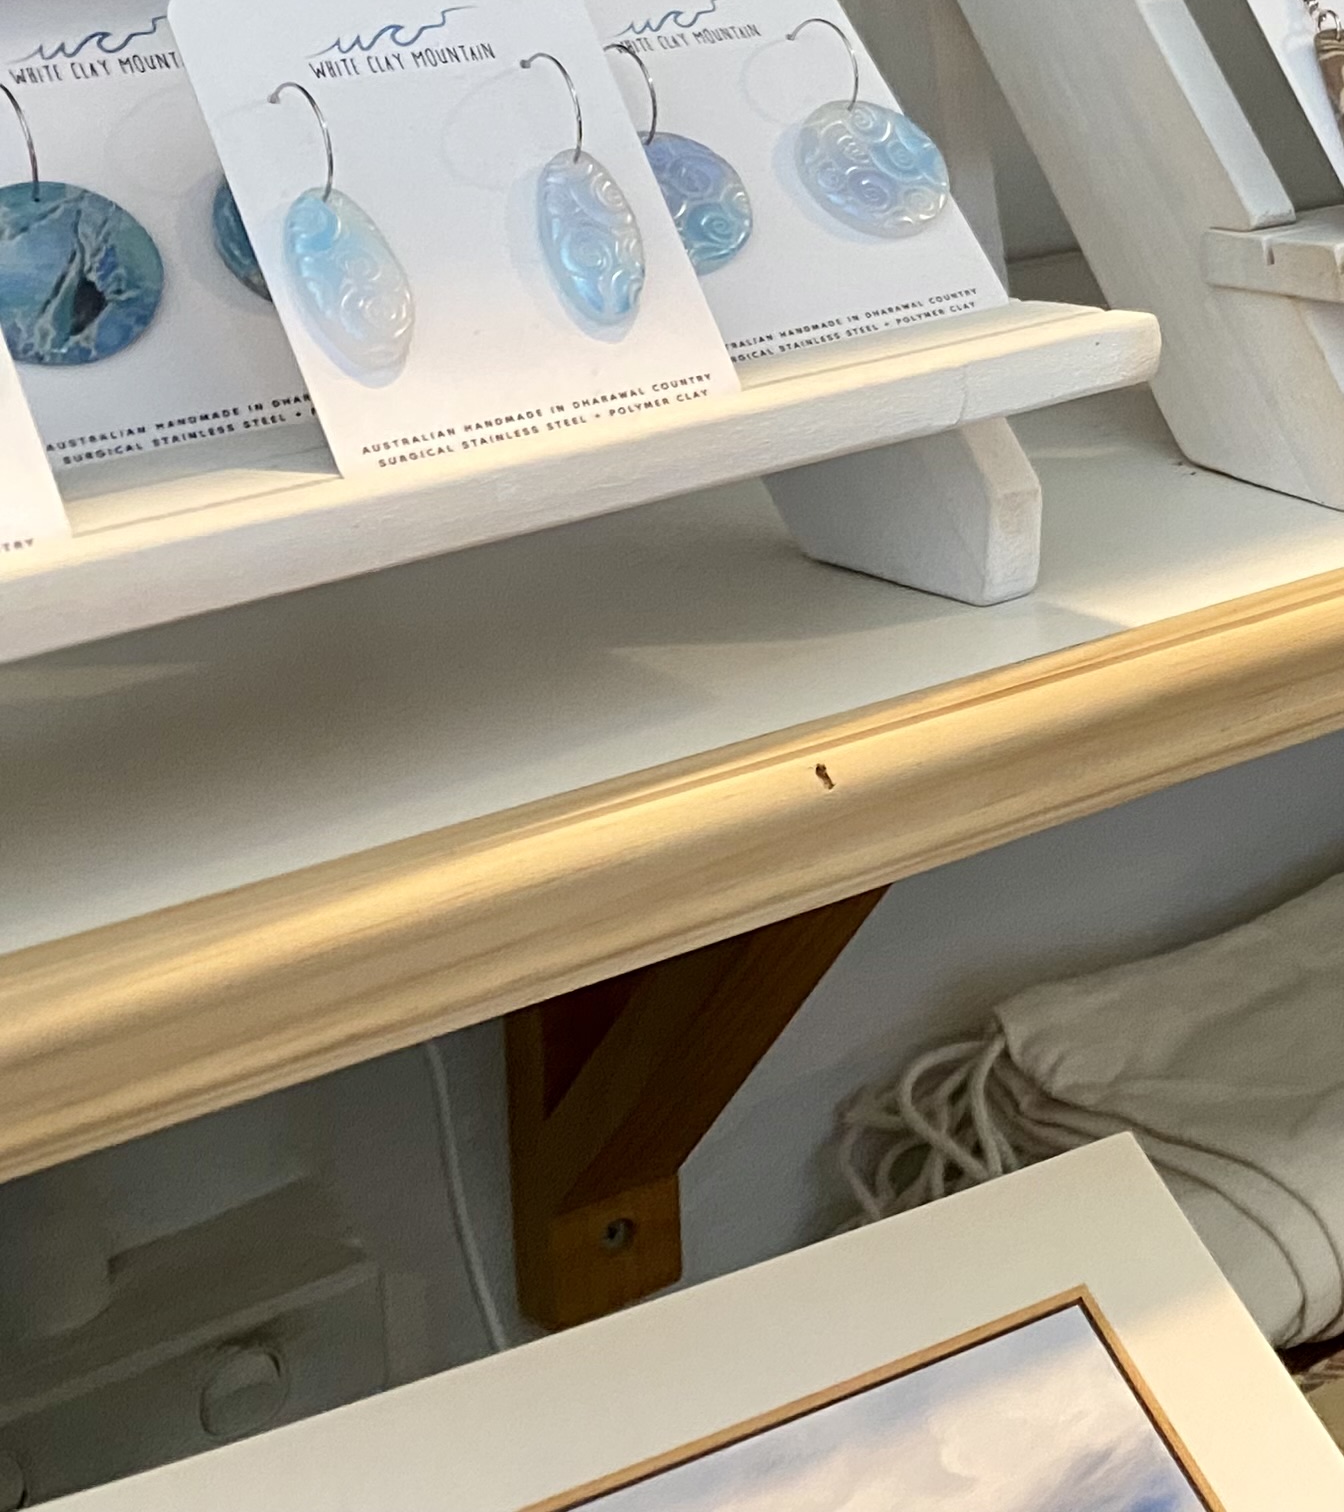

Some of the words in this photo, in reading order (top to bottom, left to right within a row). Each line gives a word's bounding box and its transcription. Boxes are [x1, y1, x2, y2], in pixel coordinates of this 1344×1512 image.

[308, 57, 360, 79] WHITE
[367, 53, 405, 74] CLAY
[411, 43, 496, 69] MOUNTAIN
[657, 32, 689, 50] CLAY
[692, 23, 761, 45] MOUNTAIN
[8, 64, 63, 85] WHITE
[70, 59, 111, 80] CLAY
[118, 51, 181, 74] MOUNT
[726, 332, 773, 350] TRALIAN
[779, 317, 843, 338] HANDMADE
[847, 312, 859, 323] IN
[864, 299, 924, 319] DHARAWAL
[928, 287, 977, 305] COUNTRY
[730, 347, 774, 364] RGICAL
[778, 331, 841, 352] STAINLESS
[845, 323, 879, 338] STEEL
[895, 308, 945, 326] POLYMER
[949, 299, 976, 314] CLAY
[46, 424, 147, 453] AUSTRALIAN
[155, 407, 240, 431] HANDMADE
[247, 402, 264, 413] IN
[271, 392, 311, 409] DHAR
[62, 442, 144, 466] SURGICAL
[152, 423, 235, 448] STAINLESS
[242, 413, 287, 430] STEEL
[362, 427, 456, 456] AUSTRALIAN
[463, 408, 543, 433] HANDMADE
[550, 403, 565, 416] IN
[572, 387, 645, 410] DHARAWAL
[651, 372, 712, 394] COUNTRY
[377, 444, 454, 468] SURGICAL
[461, 425, 540, 450] STAINLESS
[546, 414, 587, 432] STEEL
[609, 398, 670, 418] POLYMER
[676, 388, 710, 404] CLAY
